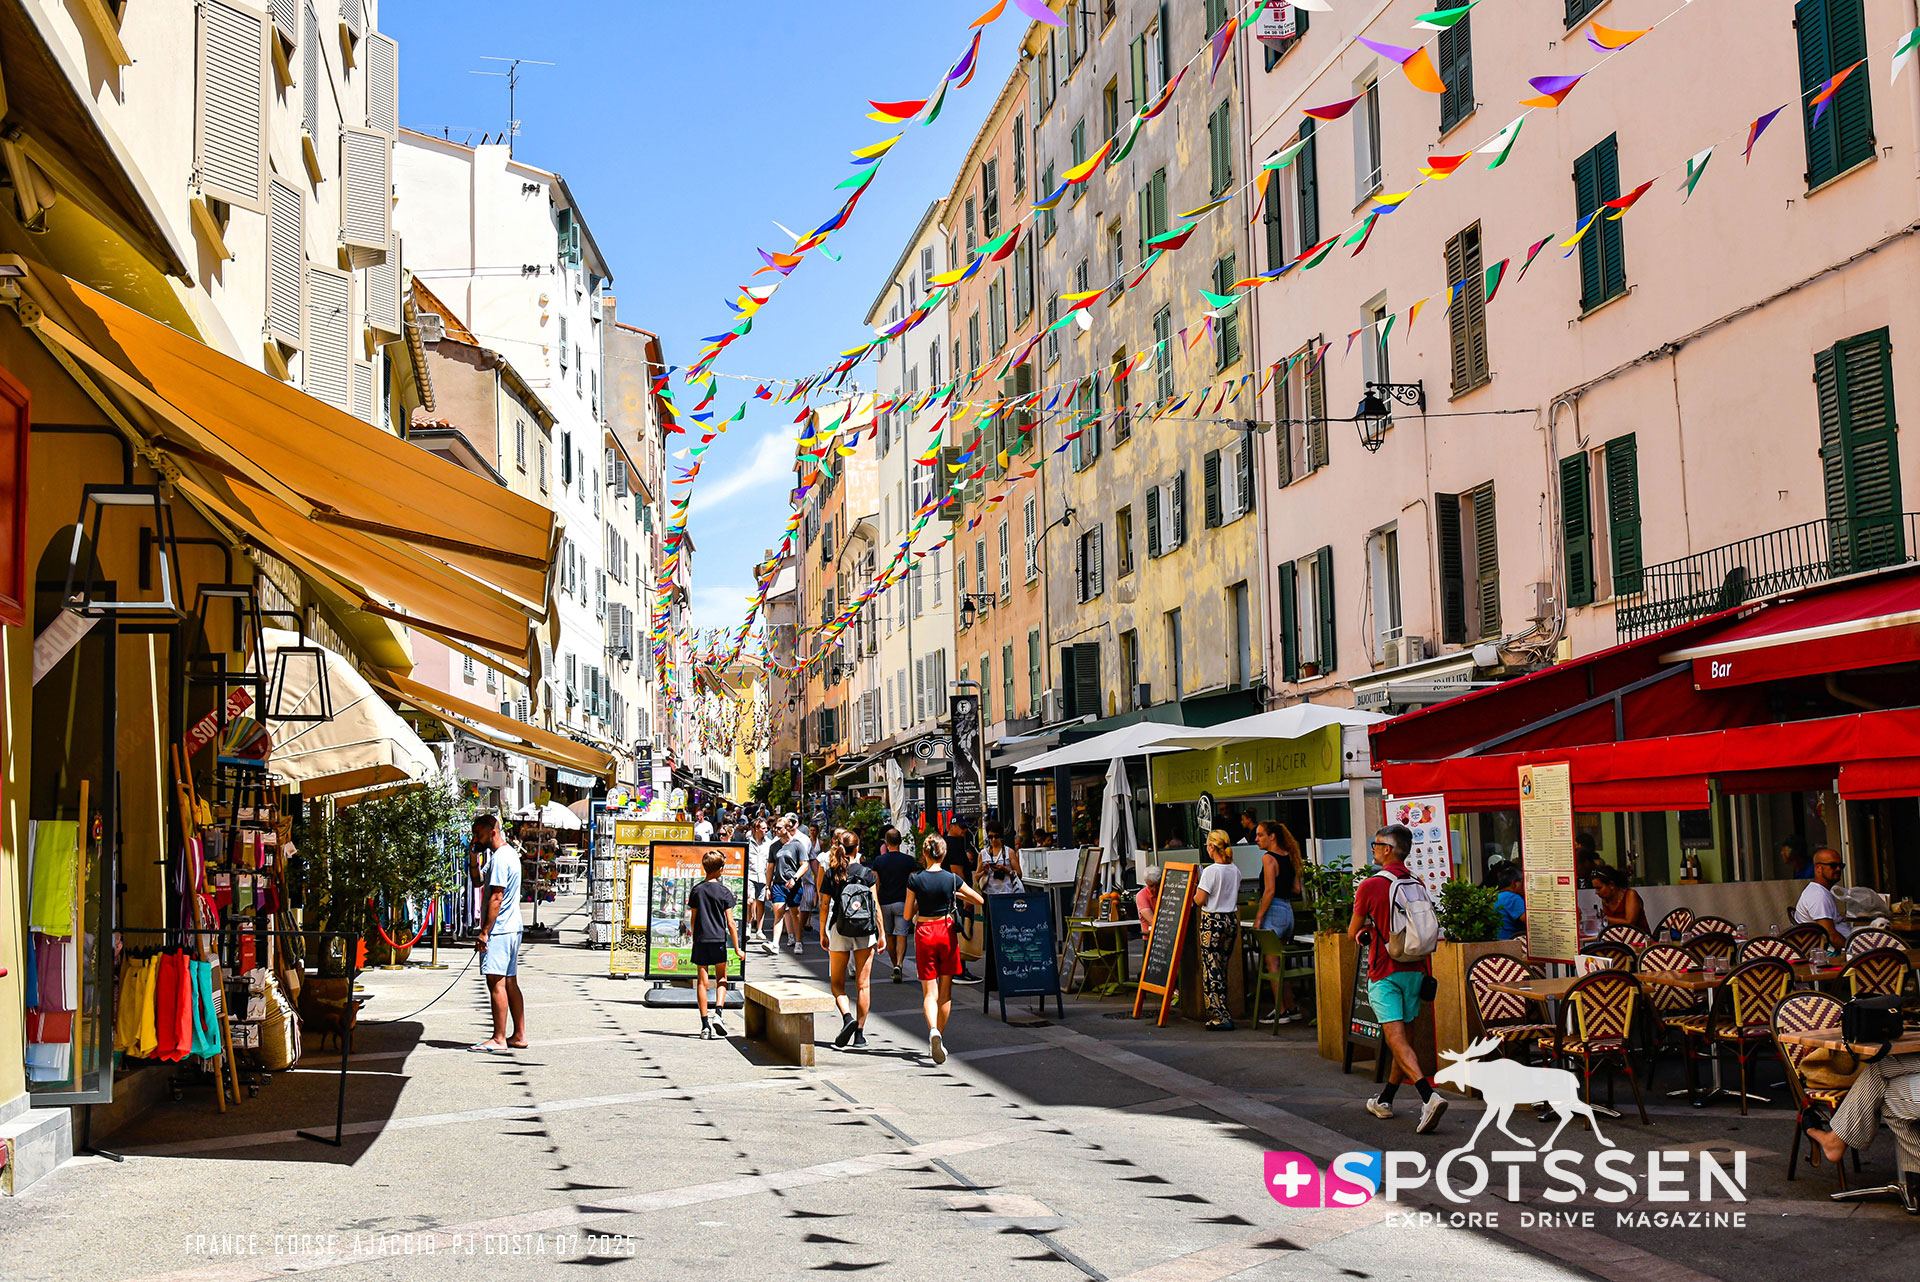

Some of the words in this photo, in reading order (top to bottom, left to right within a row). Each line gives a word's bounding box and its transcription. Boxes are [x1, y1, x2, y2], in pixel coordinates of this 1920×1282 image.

[1711, 661, 1732, 678] Bar
[1264, 753, 1307, 774] GLACIER
[621, 827, 689, 839] ROOFTOP
[660, 866, 702, 878] Natura
